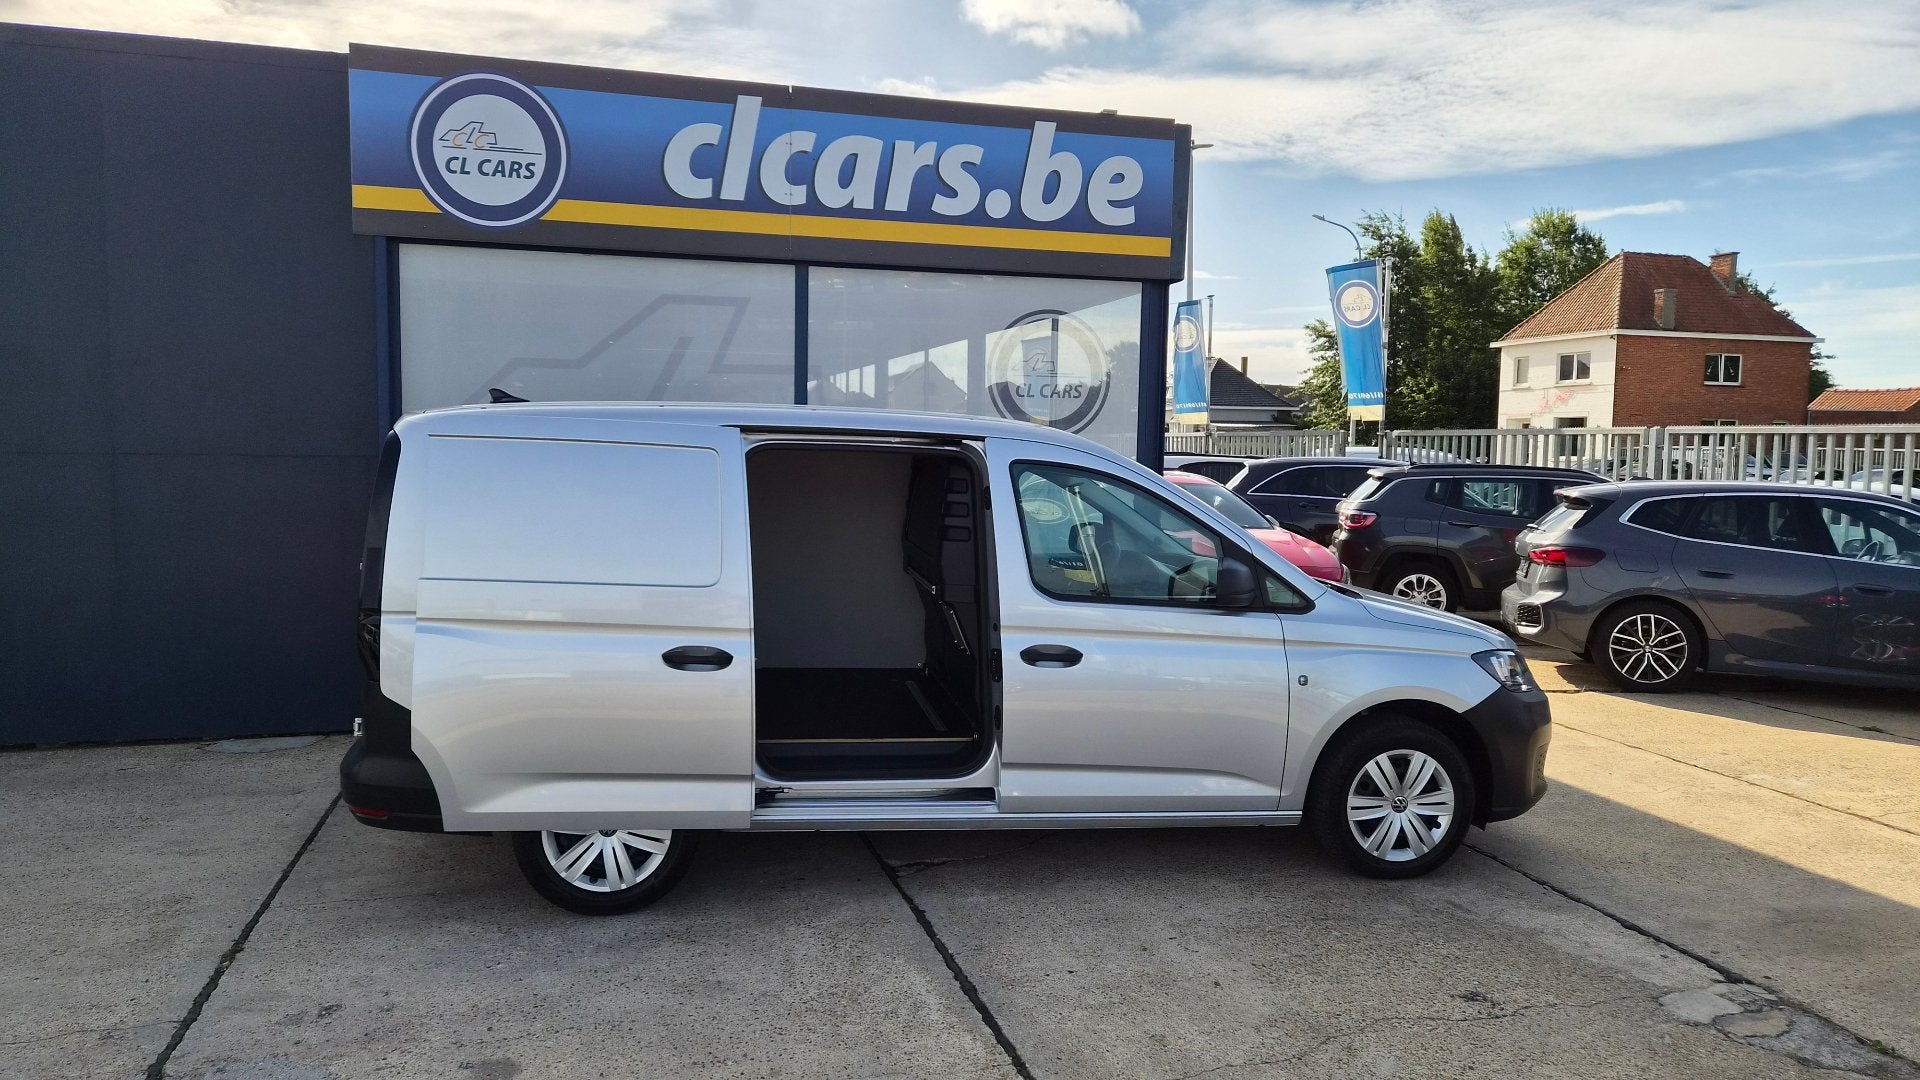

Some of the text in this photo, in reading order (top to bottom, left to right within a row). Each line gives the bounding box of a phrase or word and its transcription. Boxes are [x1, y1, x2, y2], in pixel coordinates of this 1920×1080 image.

[445, 156, 536, 180] CL CARS
[663, 94, 1144, 227] clcars.be
[1016, 383, 1083, 399] CL CARS
